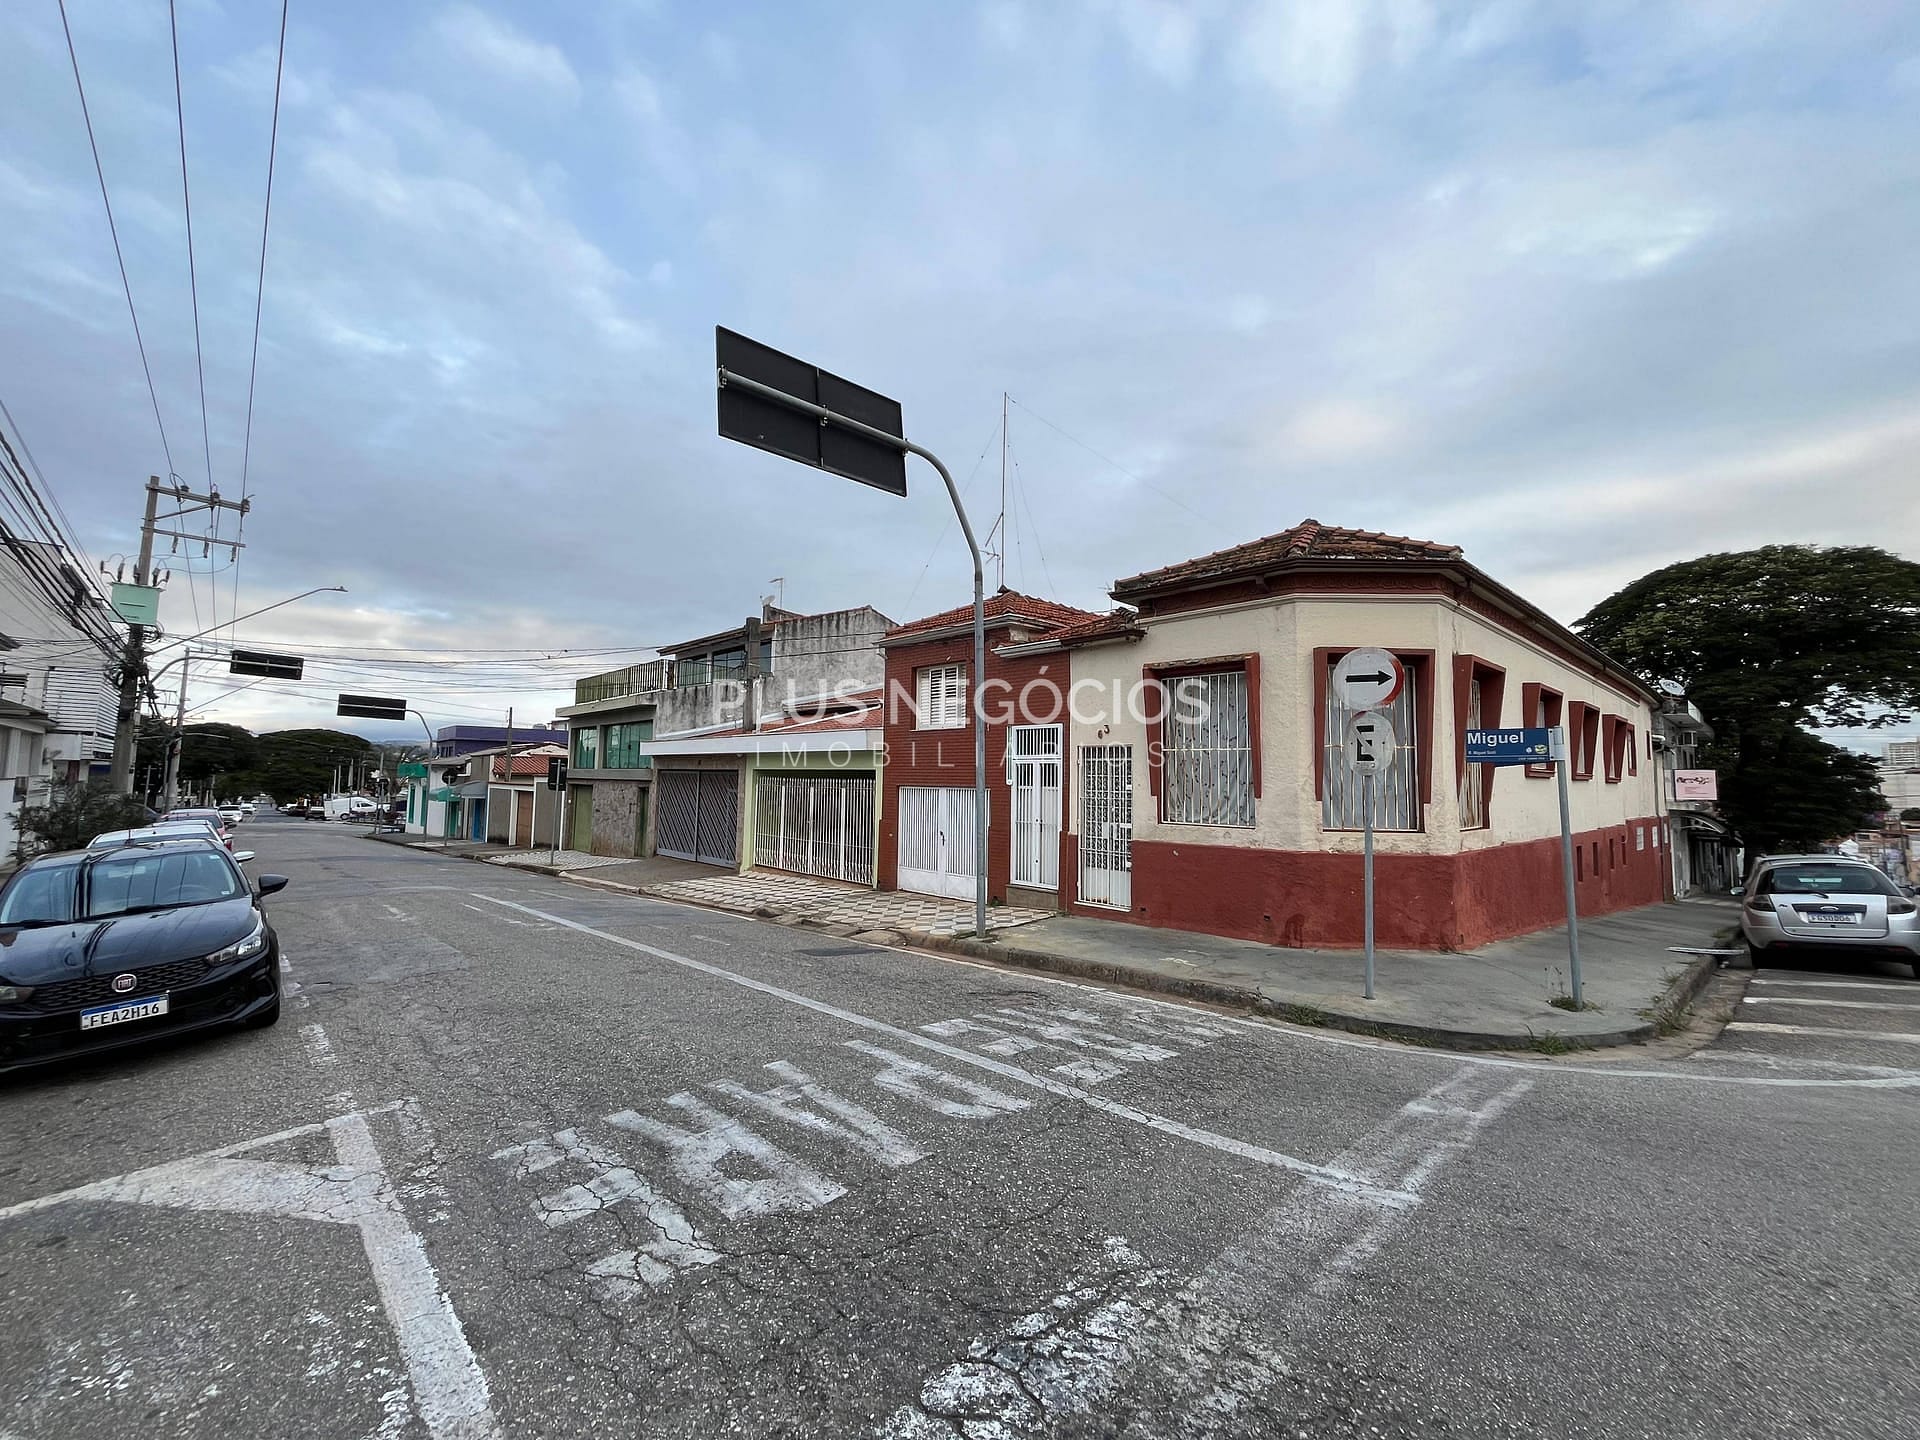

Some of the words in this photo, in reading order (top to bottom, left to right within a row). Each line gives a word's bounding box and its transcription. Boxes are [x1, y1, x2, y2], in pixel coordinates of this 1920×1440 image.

[1467, 731, 1524, 747] Miguel
[117, 978, 133, 989] FIAT
[90, 1003, 160, 1027] FEA2H16
